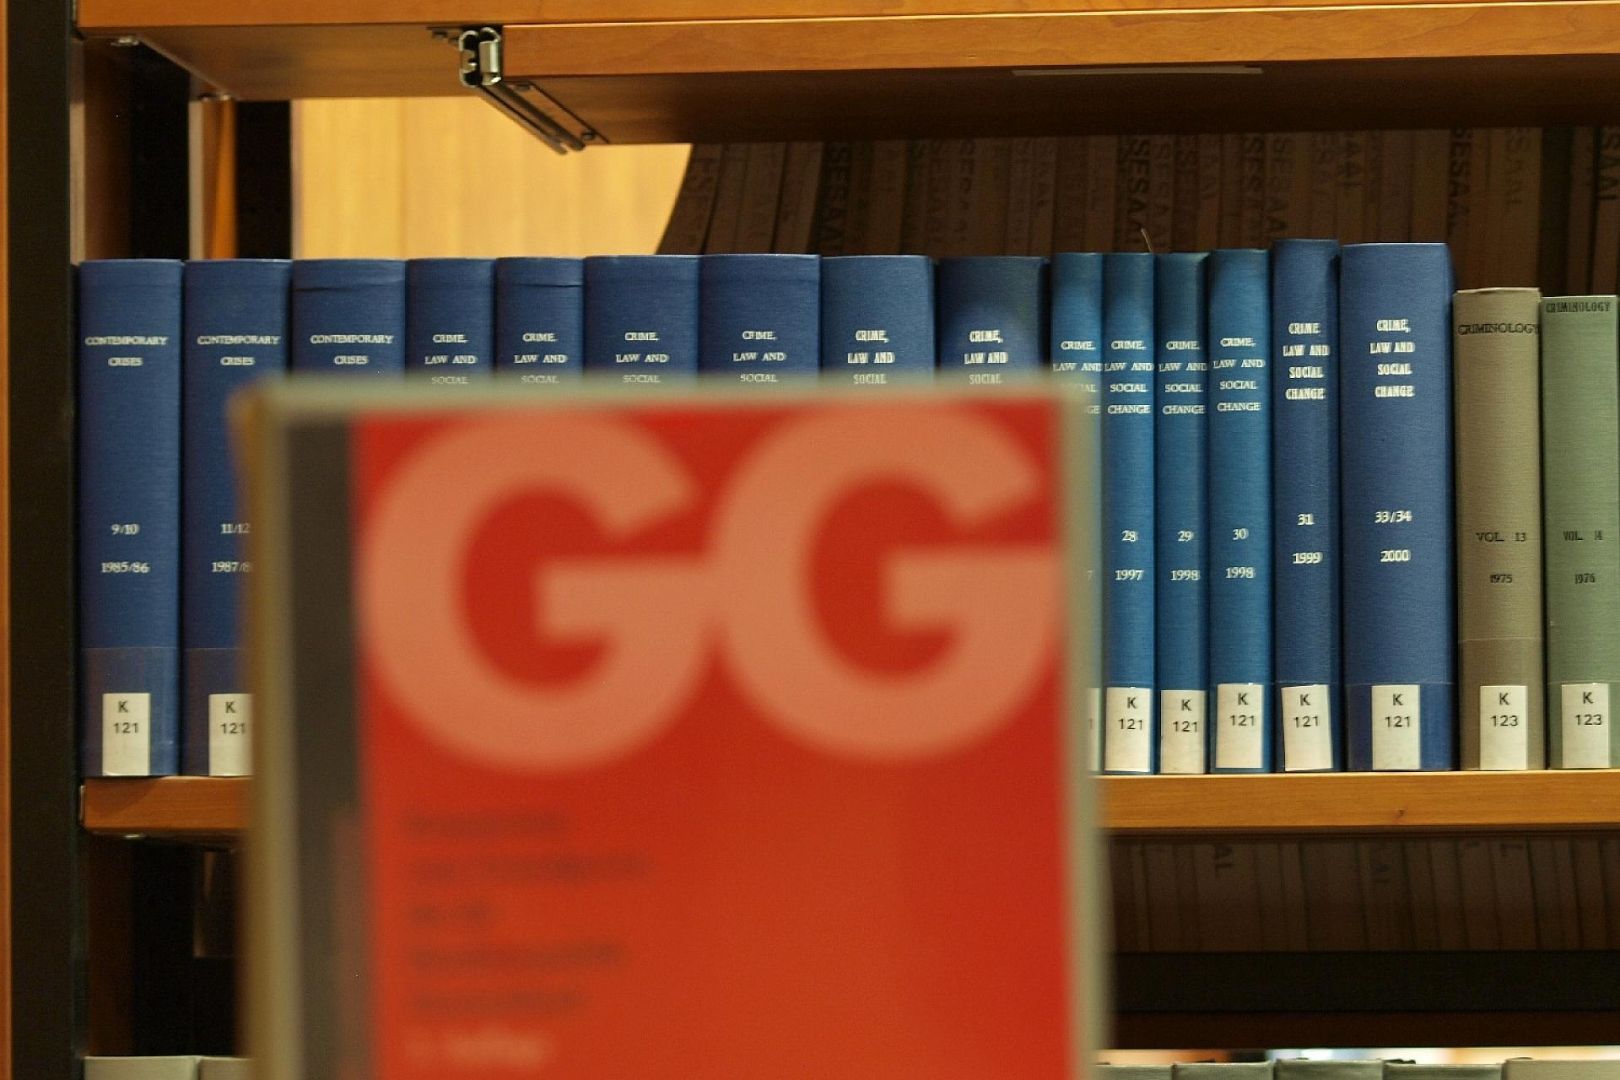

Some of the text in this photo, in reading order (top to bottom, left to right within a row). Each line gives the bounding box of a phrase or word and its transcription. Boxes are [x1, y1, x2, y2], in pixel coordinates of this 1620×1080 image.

[84, 335, 168, 346] CONTEMPORARY
[196, 334, 281, 346] CONTEMPORARY
[309, 333, 394, 345] CONTEMPORARY
[1282, 344, 1331, 357] LAW AND
[1369, 341, 1416, 355] LAW AND
[107, 356, 144, 367] CRISES
[219, 356, 256, 367] CRISES
[333, 354, 369, 366] CRISES
[424, 354, 478, 366] LAW AND
[513, 353, 568, 364] LAW AND
[615, 353, 670, 364] LAW AND
[732, 351, 787, 363] LAW AND
[847, 351, 896, 365] LAW AND
[963, 351, 1009, 366] LAW AND
[1212, 358, 1266, 370] LAW AND
[1052, 361, 1078, 373] LAW
[1103, 361, 1155, 373] LAW AND
[1158, 362, 1208, 373] LAW AND
[1288, 365, 1325, 379] SOCIAL
[1377, 362, 1413, 376] SOCIAL
[1109, 382, 1148, 394] SOCIAL
[1164, 382, 1203, 393] SOCIAL
[1219, 379, 1258, 391] SOCIAL
[1374, 384, 1415, 399] CHANGE
[1284, 387, 1326, 401] CHANGE
[1107, 404, 1151, 415] CHANGE
[1161, 404, 1206, 416] CHANGE
[1216, 401, 1262, 413] CHANGE
[1297, 513, 1315, 526] 31
[1374, 509, 1413, 524] 33/34
[110, 523, 140, 536] 9/10
[1121, 529, 1139, 543] 28
[1177, 529, 1195, 543] 29
[1232, 527, 1249, 541] 30
[1514, 531, 1528, 543] 13
[1292, 551, 1323, 565] 1999
[1380, 548, 1411, 563] 2000
[101, 560, 151, 574] 1985/86
[1225, 566, 1256, 579] 1998
[1115, 568, 1145, 581] 1997
[1171, 569, 1201, 582] 1998
[360, 397, 1062, 774] GG
[1126, 696, 1137, 710] K
[1180, 698, 1192, 712] K
[1237, 692, 1249, 706] K
[1299, 693, 1311, 707] K
[1392, 693, 1404, 707] K
[1498, 692, 1510, 706] K
[1582, 691, 1594, 705] K
[117, 700, 130, 714] K
[224, 700, 237, 714] K
[1118, 717, 1144, 731] 121
[1173, 720, 1200, 733] 121
[1229, 713, 1256, 727] 121
[1293, 714, 1320, 729] 121
[1384, 714, 1411, 729] 121
[1490, 714, 1519, 728] 123
[1574, 713, 1604, 726] 123
[113, 721, 140, 735] 121
[220, 721, 247, 735] 121
